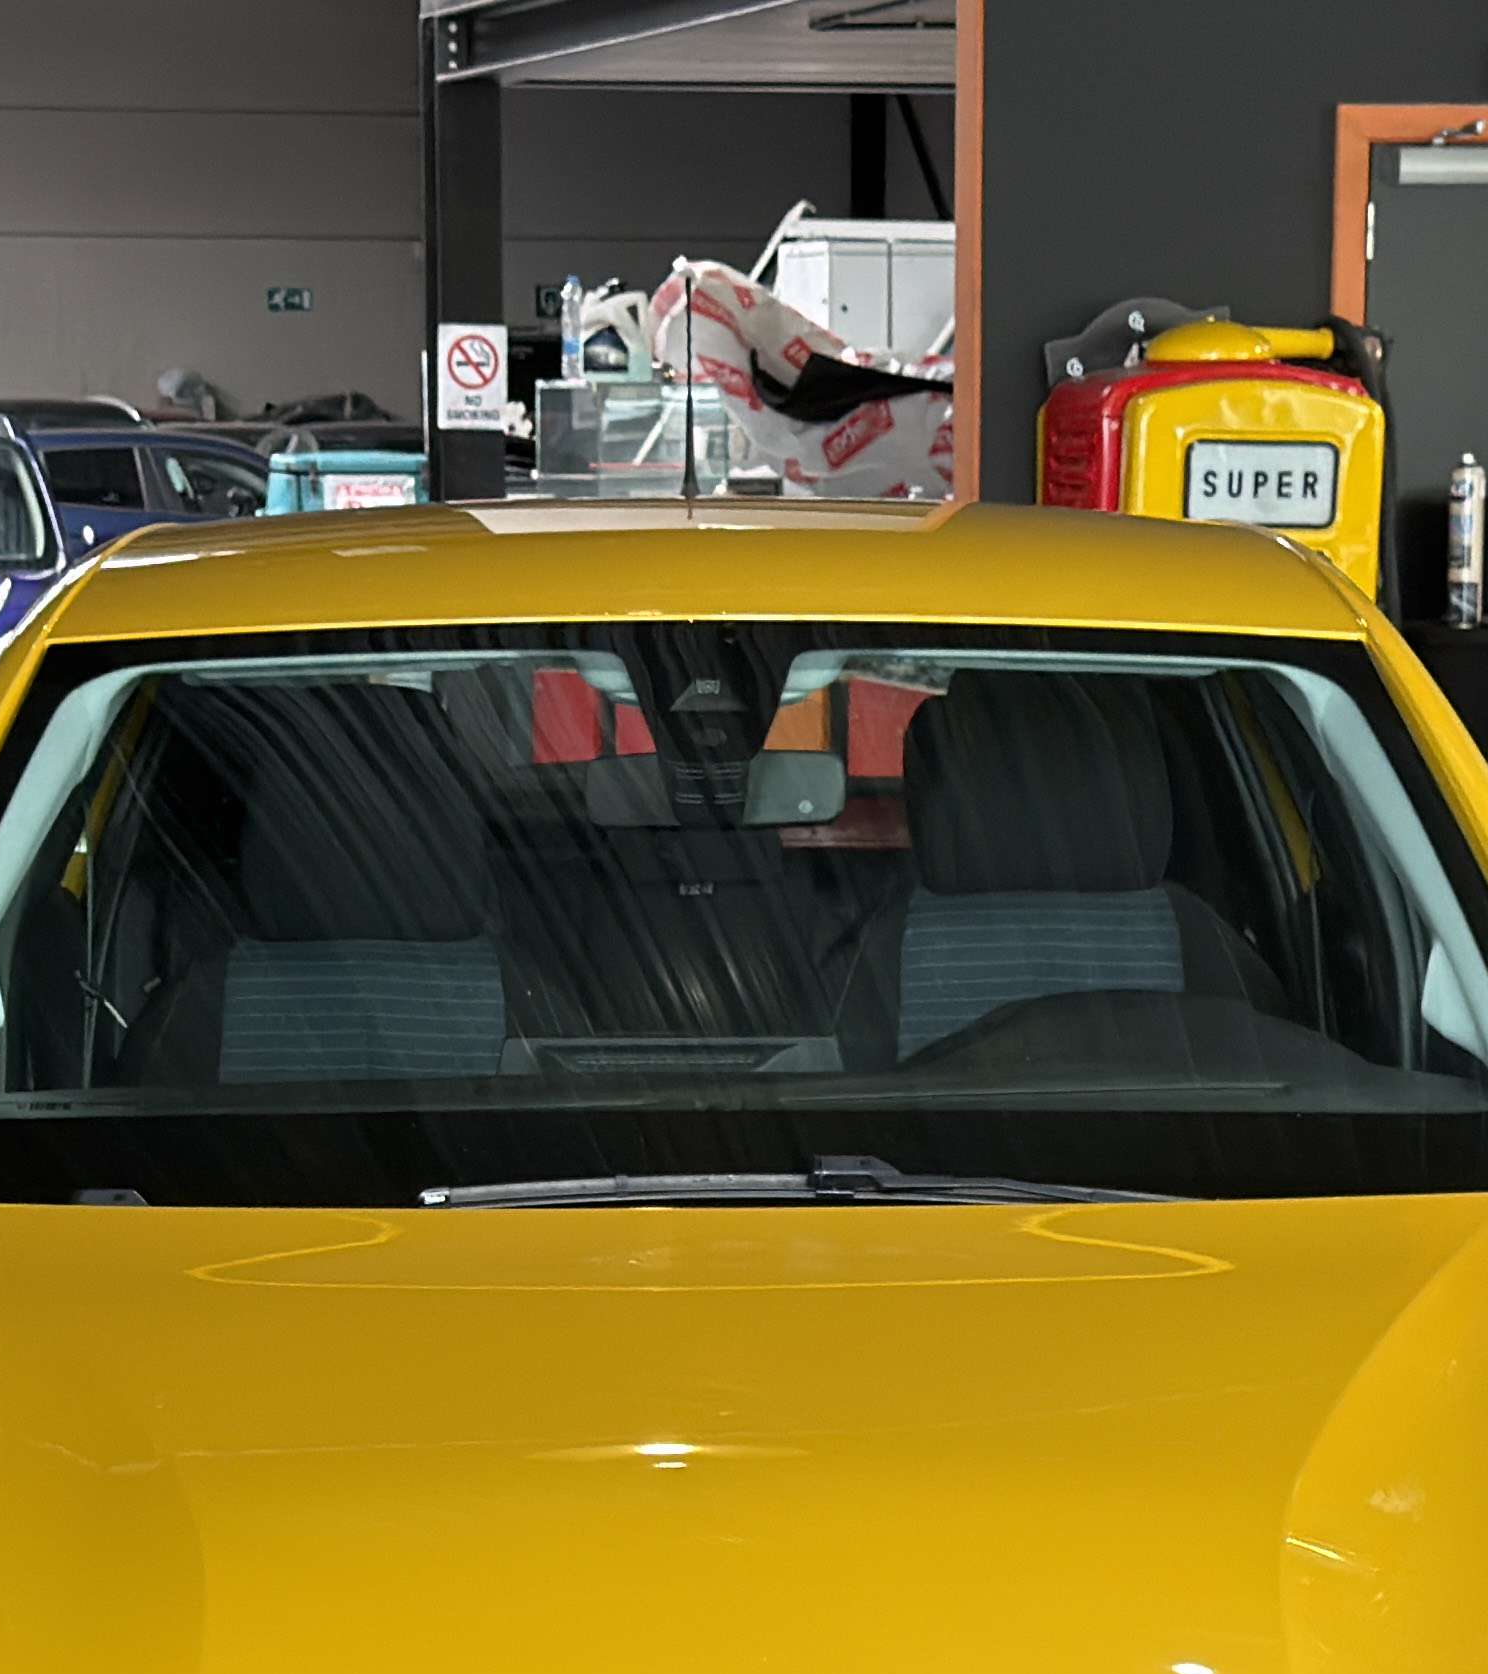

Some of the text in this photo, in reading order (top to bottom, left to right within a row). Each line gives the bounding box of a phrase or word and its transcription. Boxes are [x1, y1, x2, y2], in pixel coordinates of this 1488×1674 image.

[465, 395, 482, 407] NO
[447, 410, 500, 421] SMOKING
[1202, 470, 1319, 499] SUPER
